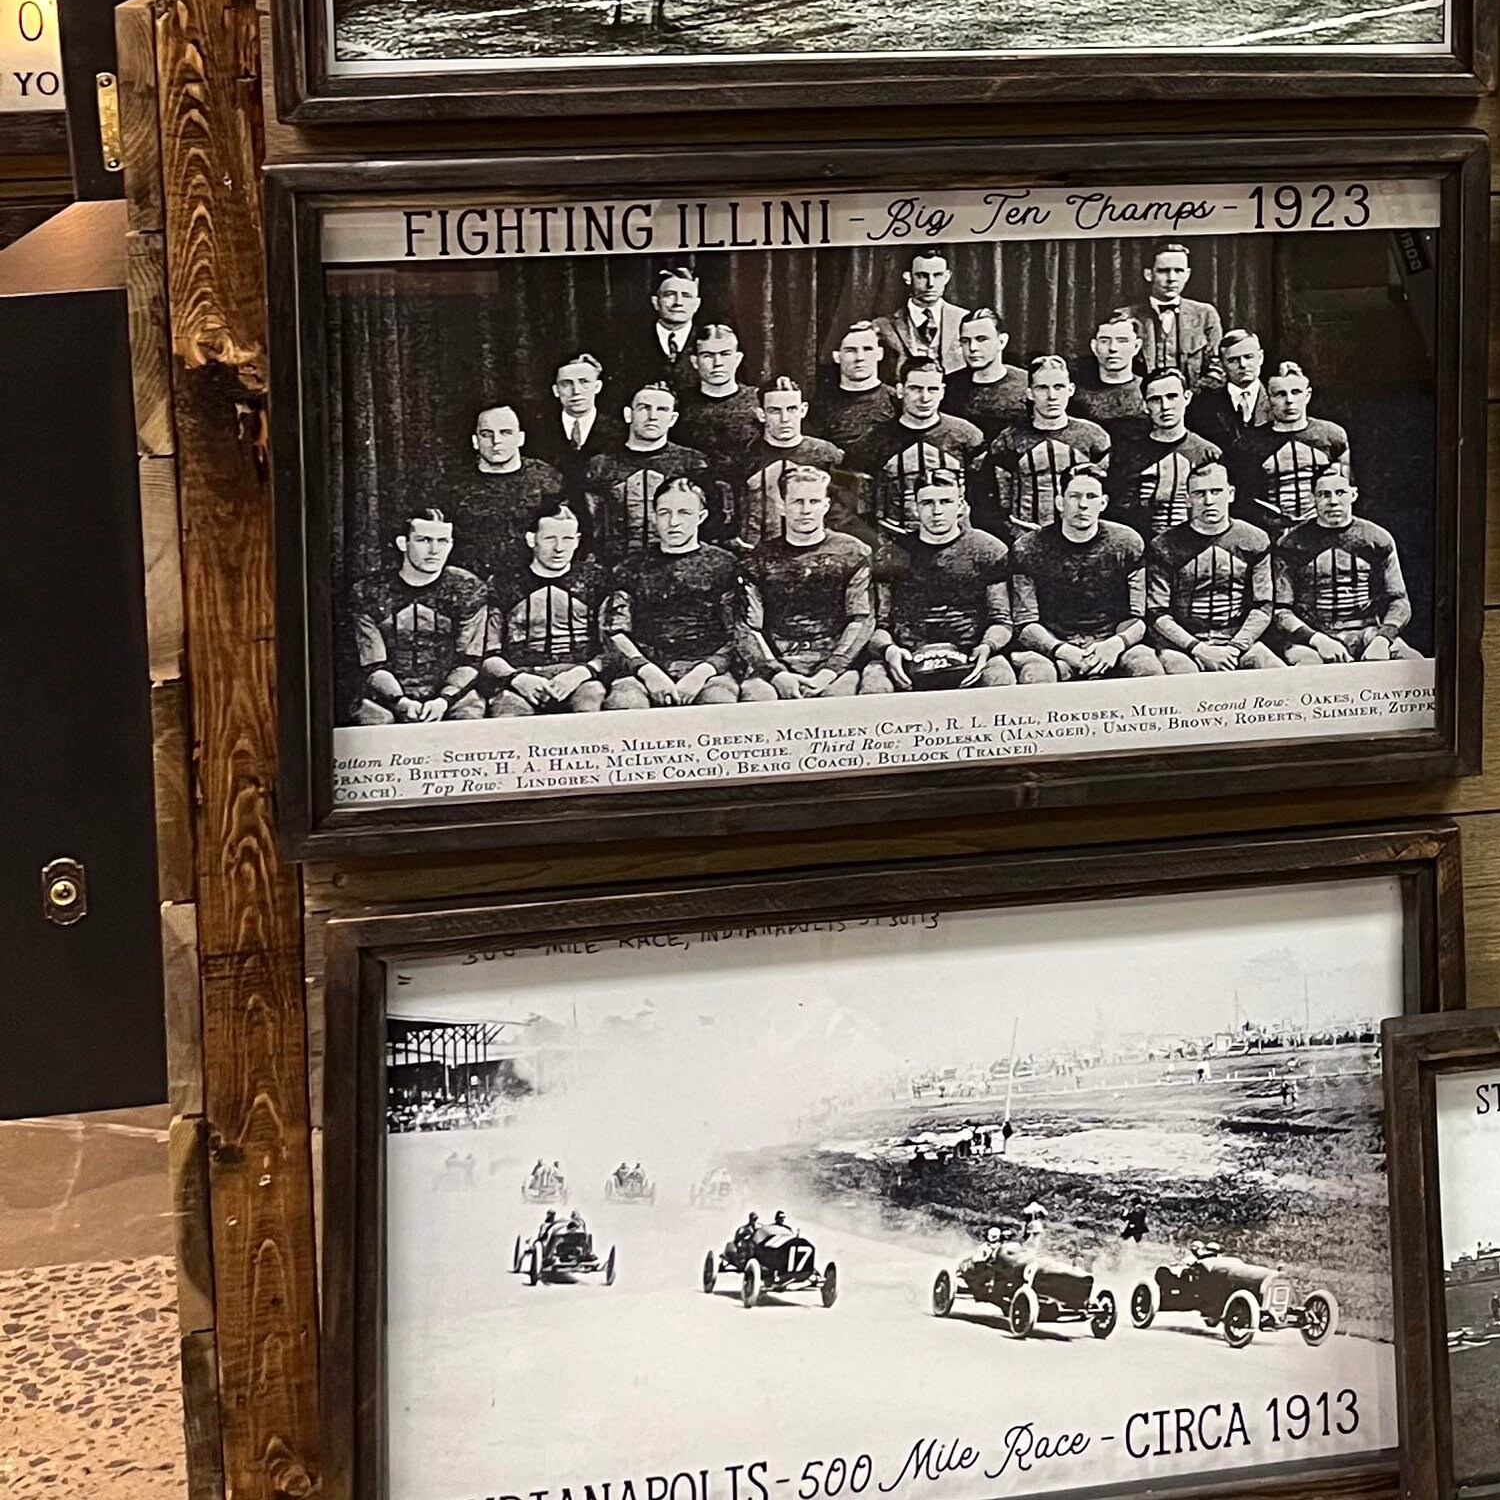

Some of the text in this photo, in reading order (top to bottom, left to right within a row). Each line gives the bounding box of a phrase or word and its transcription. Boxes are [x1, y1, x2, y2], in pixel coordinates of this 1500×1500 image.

[403, 183, 1372, 258] FIGHTING ILLINI Big Ten Champs 1923
[390, 753, 431, 768] Row:
[443, 750, 521, 764] SCHULTZ,
[528, 743, 615, 758] RICHARDS,
[622, 737, 692, 751] MILLER,
[697, 733, 770, 747] GREENE,
[776, 726, 868, 742] McMILLEN
[945, 716, 964, 731] R.
[971, 714, 988, 730] L.
[994, 713, 1041, 728] HALL,
[1047, 708, 1125, 724] ROKUSEK,
[1196, 700, 1247, 714] Second
[1252, 696, 1291, 710] Row:
[1300, 692, 1355, 706] OAKES,
[409, 767, 489, 782] BRITTON,
[549, 757, 600, 772] HALL,
[809, 739, 855, 754] Third
[861, 736, 903, 751] Row:
[913, 733, 994, 748] PODLESAK
[1103, 719, 1163, 735] UMNUS,
[1168, 716, 1229, 730] BROWN,
[1235, 710, 1308, 725] ROBERTS,
[1312, 705, 1383, 719] SLIMMER,
[422, 781, 455, 797] Top
[516, 773, 600, 790] LINDGREN
[608, 768, 657, 786] (LINE
[737, 760, 791, 775] BEARG
[877, 750, 950, 766] BULLOCK
[785, 1235, 817, 1273] 17
[798, 1387, 1361, 1500] 500 Mile Race CIRCA 1913
